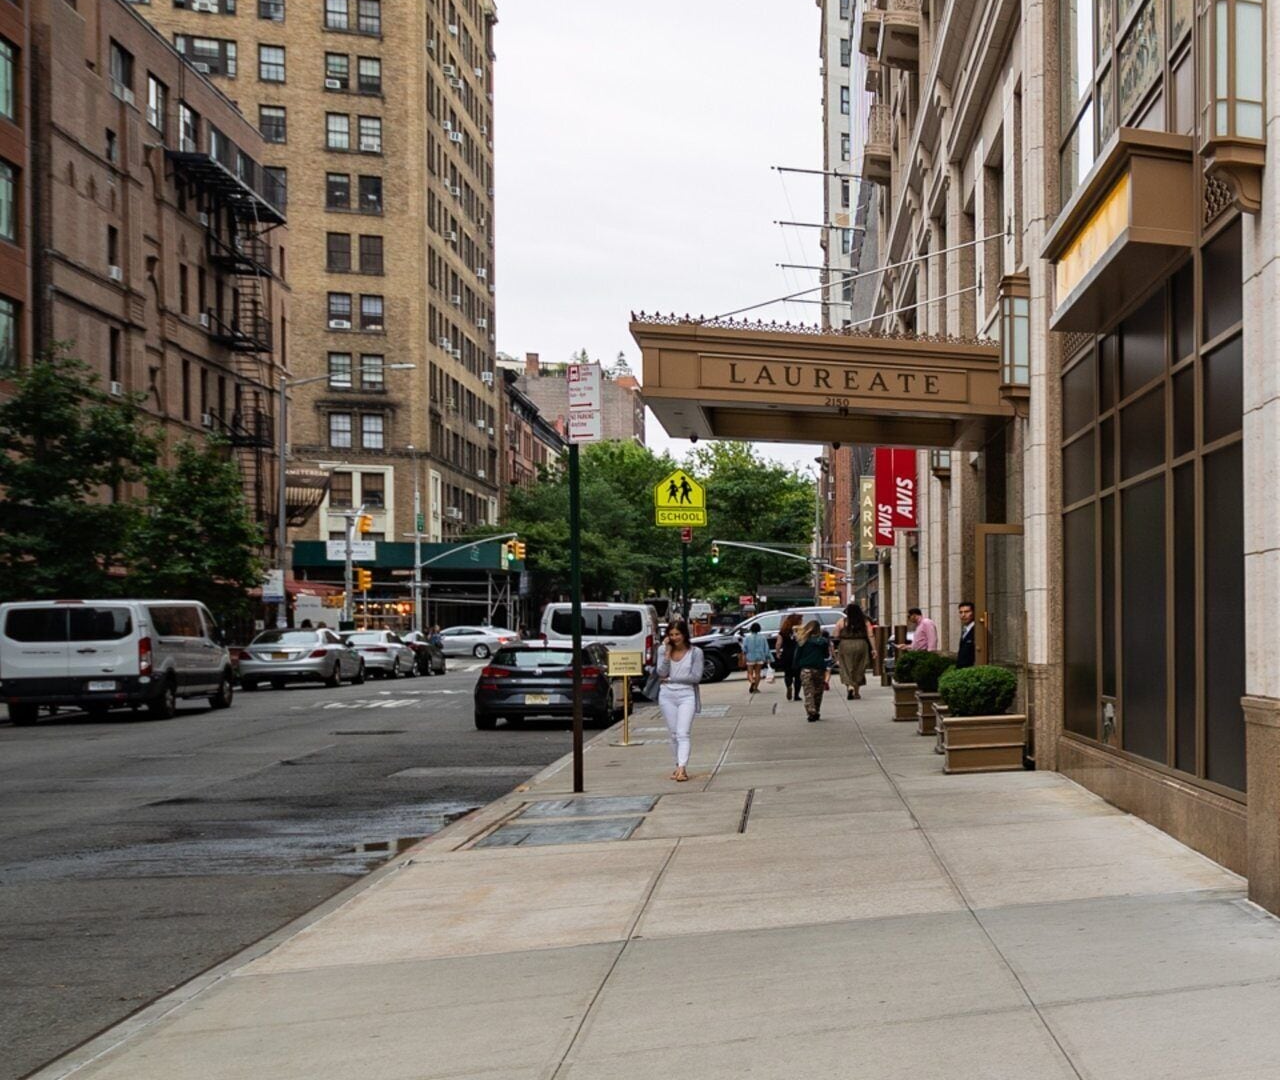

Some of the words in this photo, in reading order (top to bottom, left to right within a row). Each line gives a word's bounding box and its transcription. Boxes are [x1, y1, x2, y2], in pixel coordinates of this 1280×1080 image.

[729, 362, 940, 395] LAUREATE
[824, 396, 850, 407] 2150
[863, 483, 873, 538] PARK
[896, 477, 913, 520] AVIS
[660, 512, 702, 521] SCHOOL
[878, 504, 893, 539] AVIS
